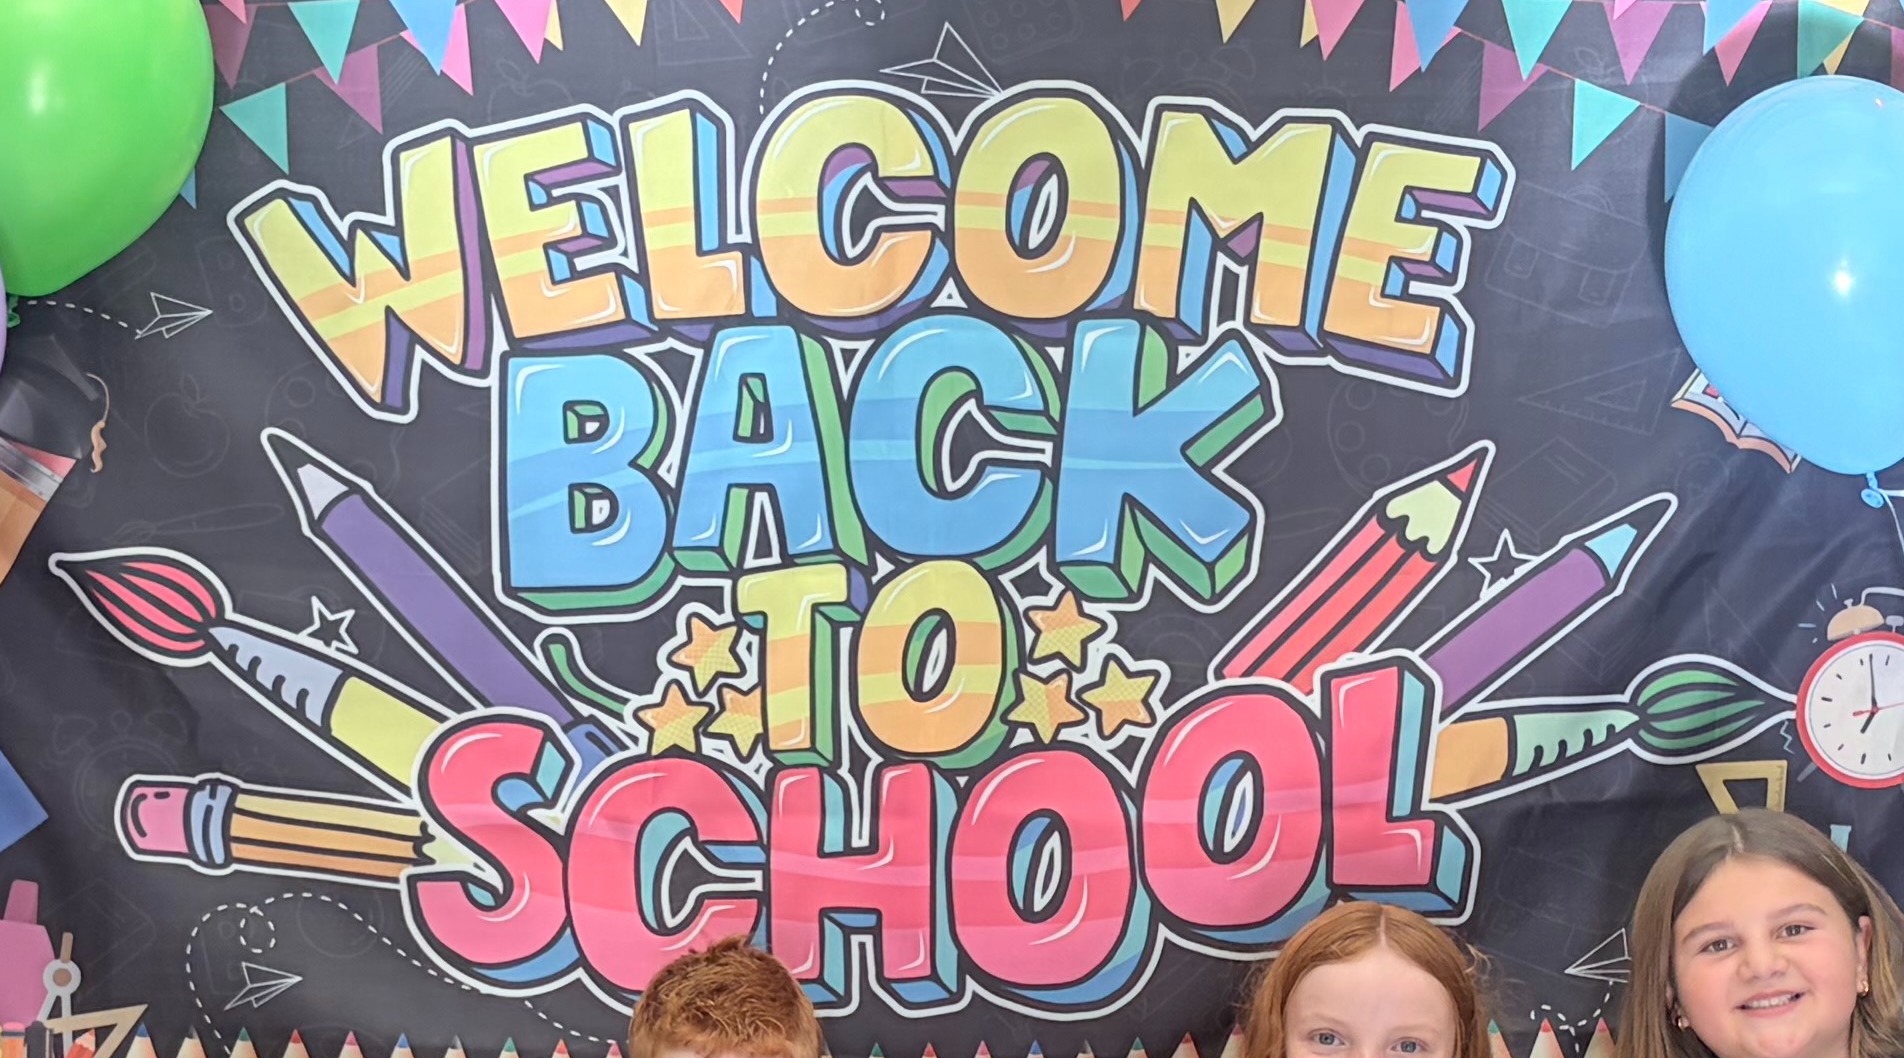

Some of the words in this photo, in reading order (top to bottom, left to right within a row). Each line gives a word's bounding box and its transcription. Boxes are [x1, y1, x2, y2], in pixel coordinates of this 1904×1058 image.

[246, 92, 1510, 408] WELCOME
[499, 318, 1274, 612] BACK
[736, 560, 1014, 768] TO
[416, 658, 1464, 1004] SCHOOL
